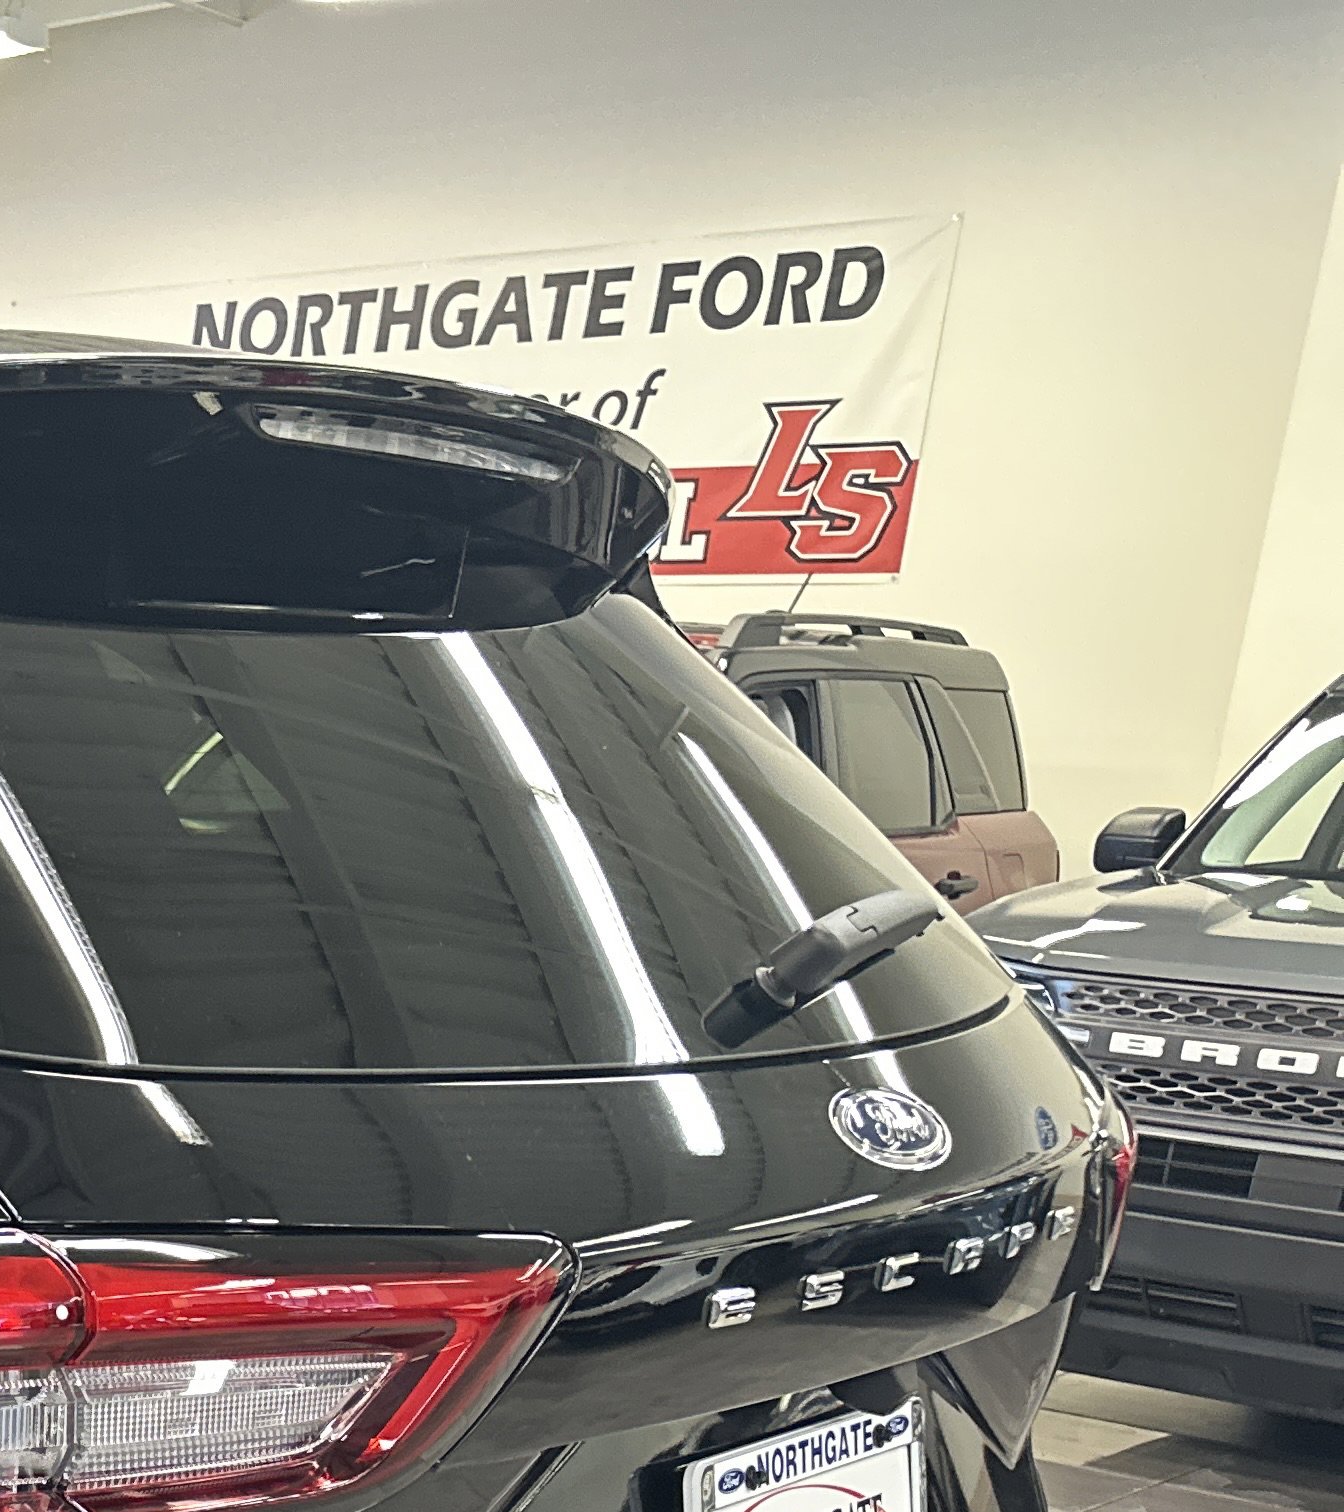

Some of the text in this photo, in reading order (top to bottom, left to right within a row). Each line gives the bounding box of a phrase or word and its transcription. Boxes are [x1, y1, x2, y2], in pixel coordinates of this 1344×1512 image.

[192, 246, 885, 357] NORTHGATE FORD
[592, 368, 667, 429] of
[716, 398, 912, 564] LS
[1109, 1031, 1344, 1078] BRO
[707, 1206, 1075, 1328] ESCAPE
[757, 1419, 873, 1486] NORTHGATE
